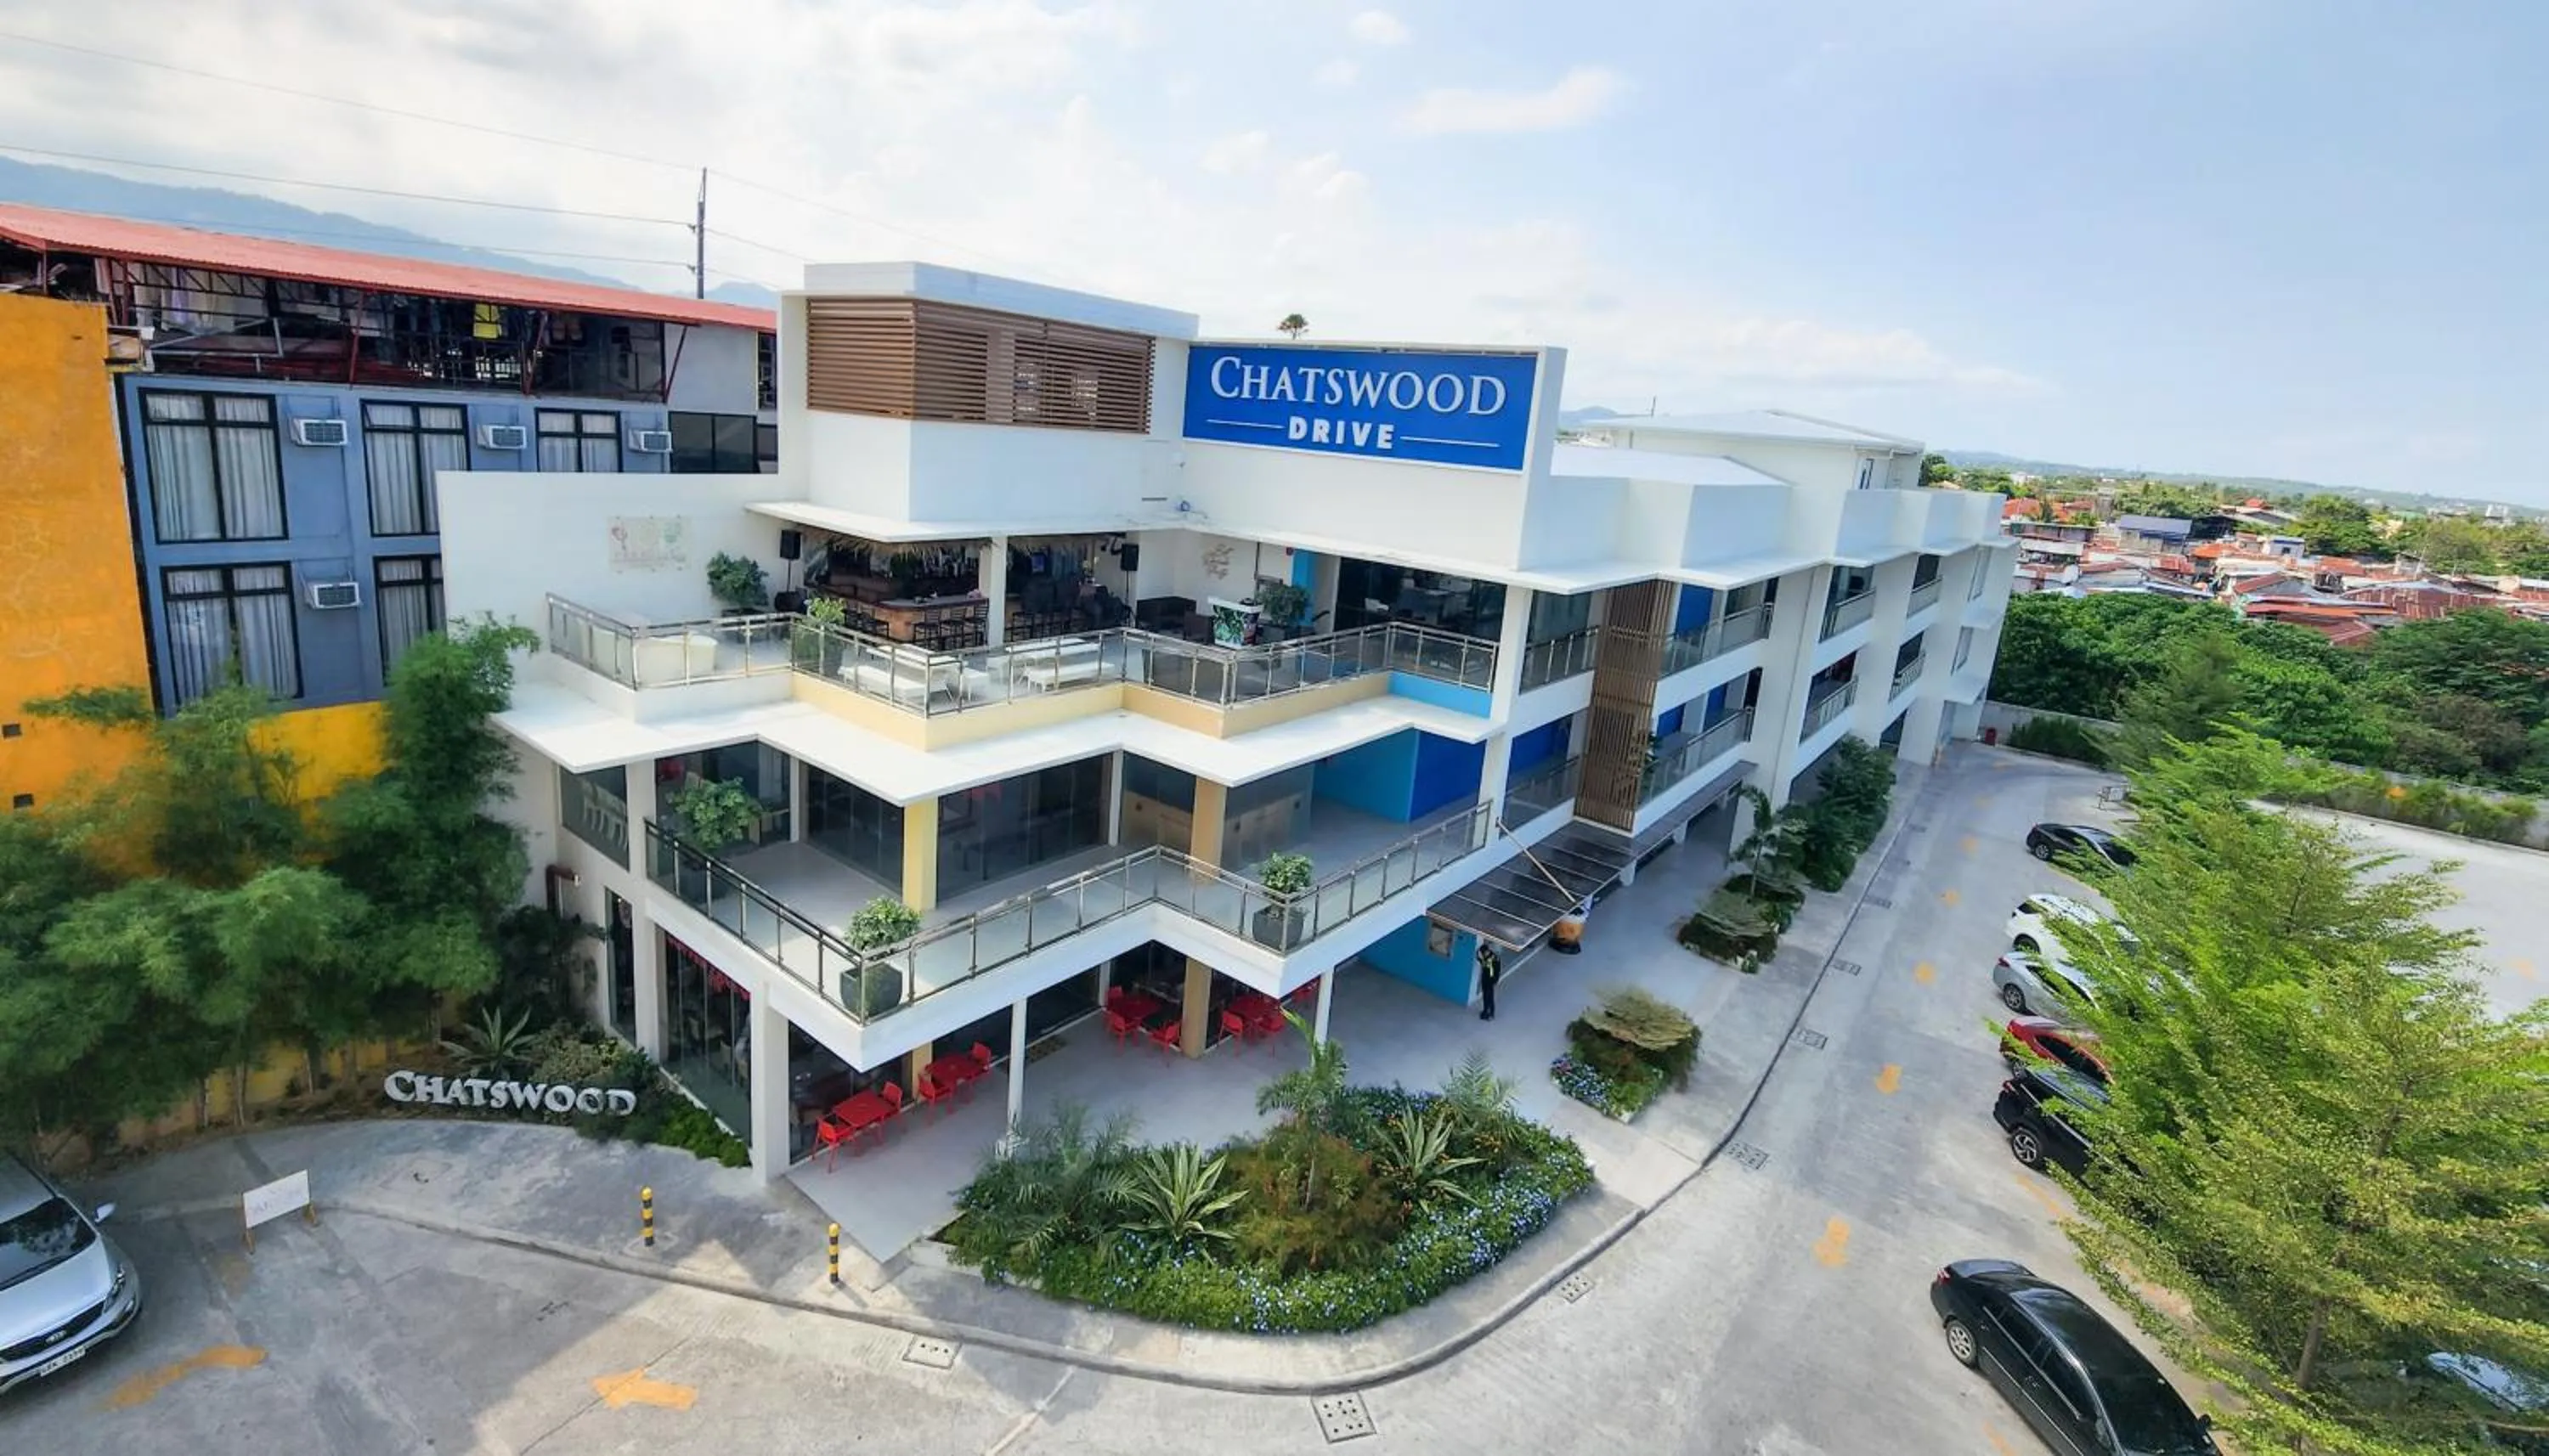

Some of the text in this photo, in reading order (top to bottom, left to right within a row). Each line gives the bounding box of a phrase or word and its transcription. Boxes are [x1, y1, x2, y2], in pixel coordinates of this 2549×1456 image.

[1211, 356, 1506, 415] CHATSWOOD
[1288, 415, 1394, 449] DRIVE
[384, 1069, 636, 1115] CHATSWOOD
